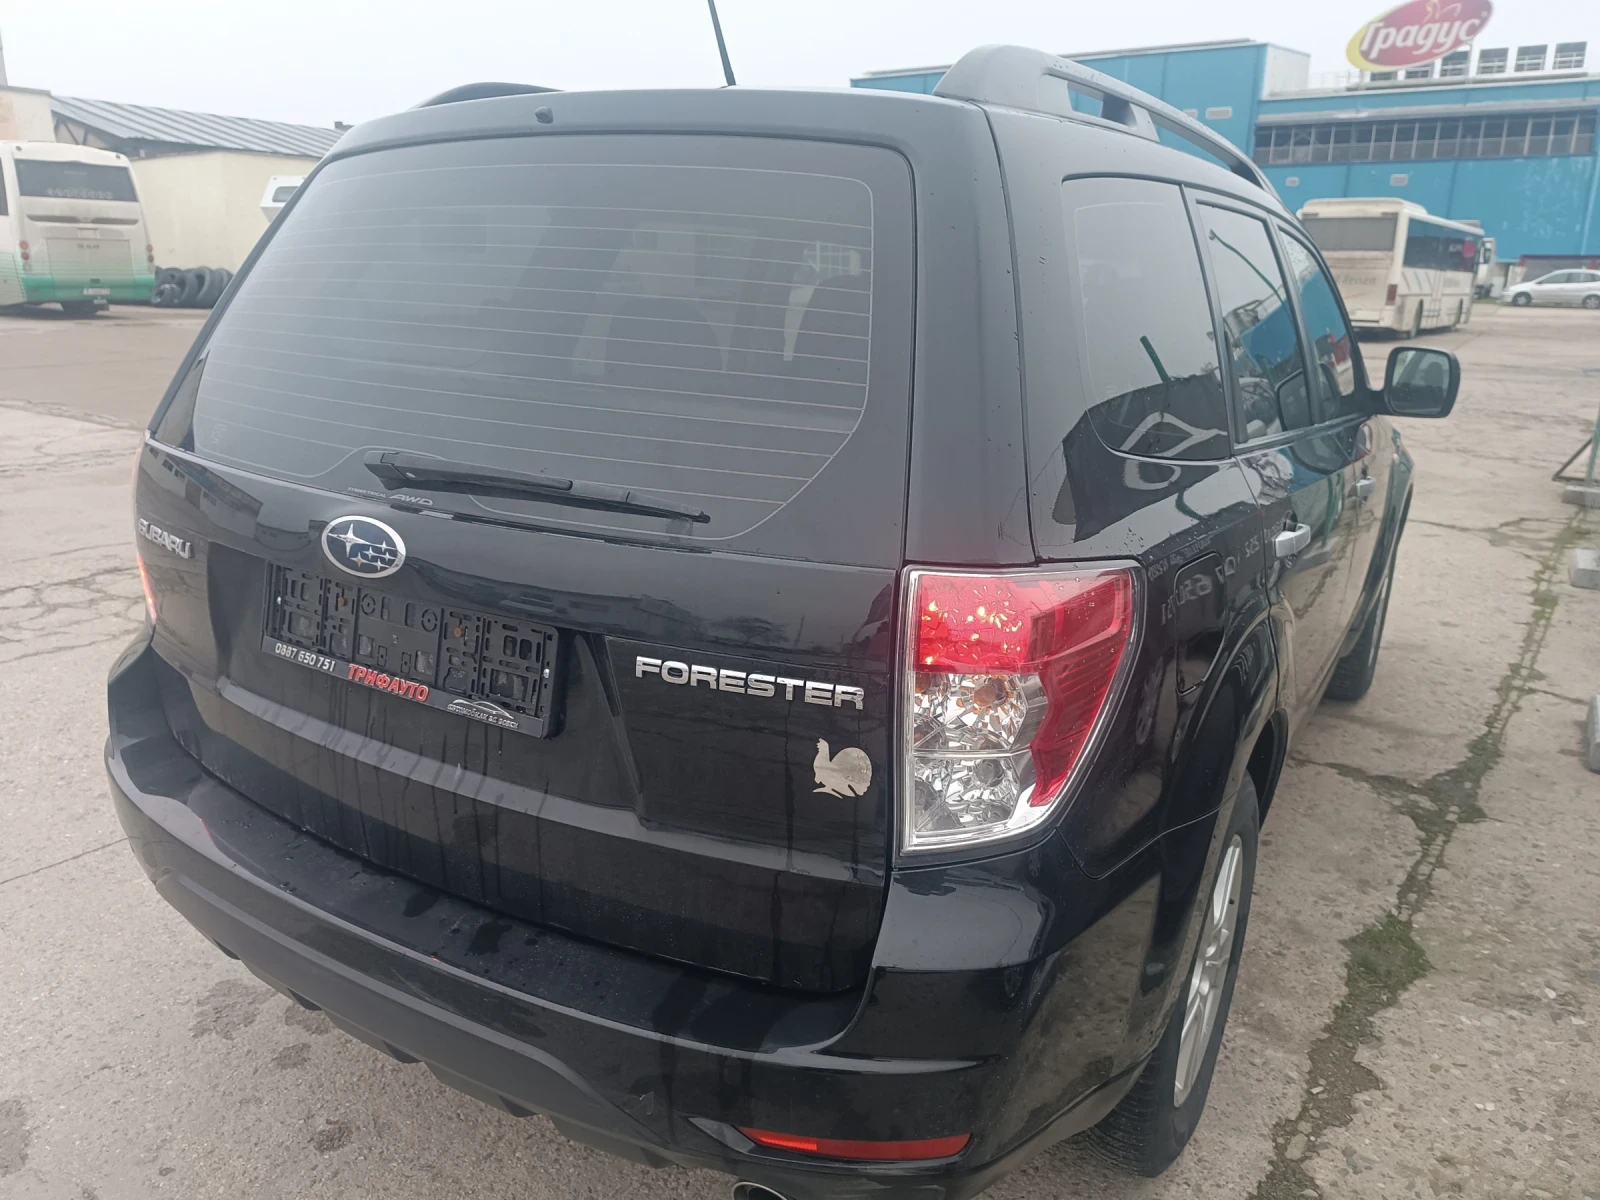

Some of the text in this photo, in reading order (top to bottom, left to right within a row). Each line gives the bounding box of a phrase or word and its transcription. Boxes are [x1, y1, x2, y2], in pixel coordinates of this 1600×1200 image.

[1360, 18, 1481, 60] Градус
[389, 493, 434, 506] AWD
[138, 518, 191, 560] SUBARU
[274, 642, 336, 673] 0887 650 751
[348, 663, 430, 703] ТРИФАУТО
[635, 656, 865, 711] FORESTER
